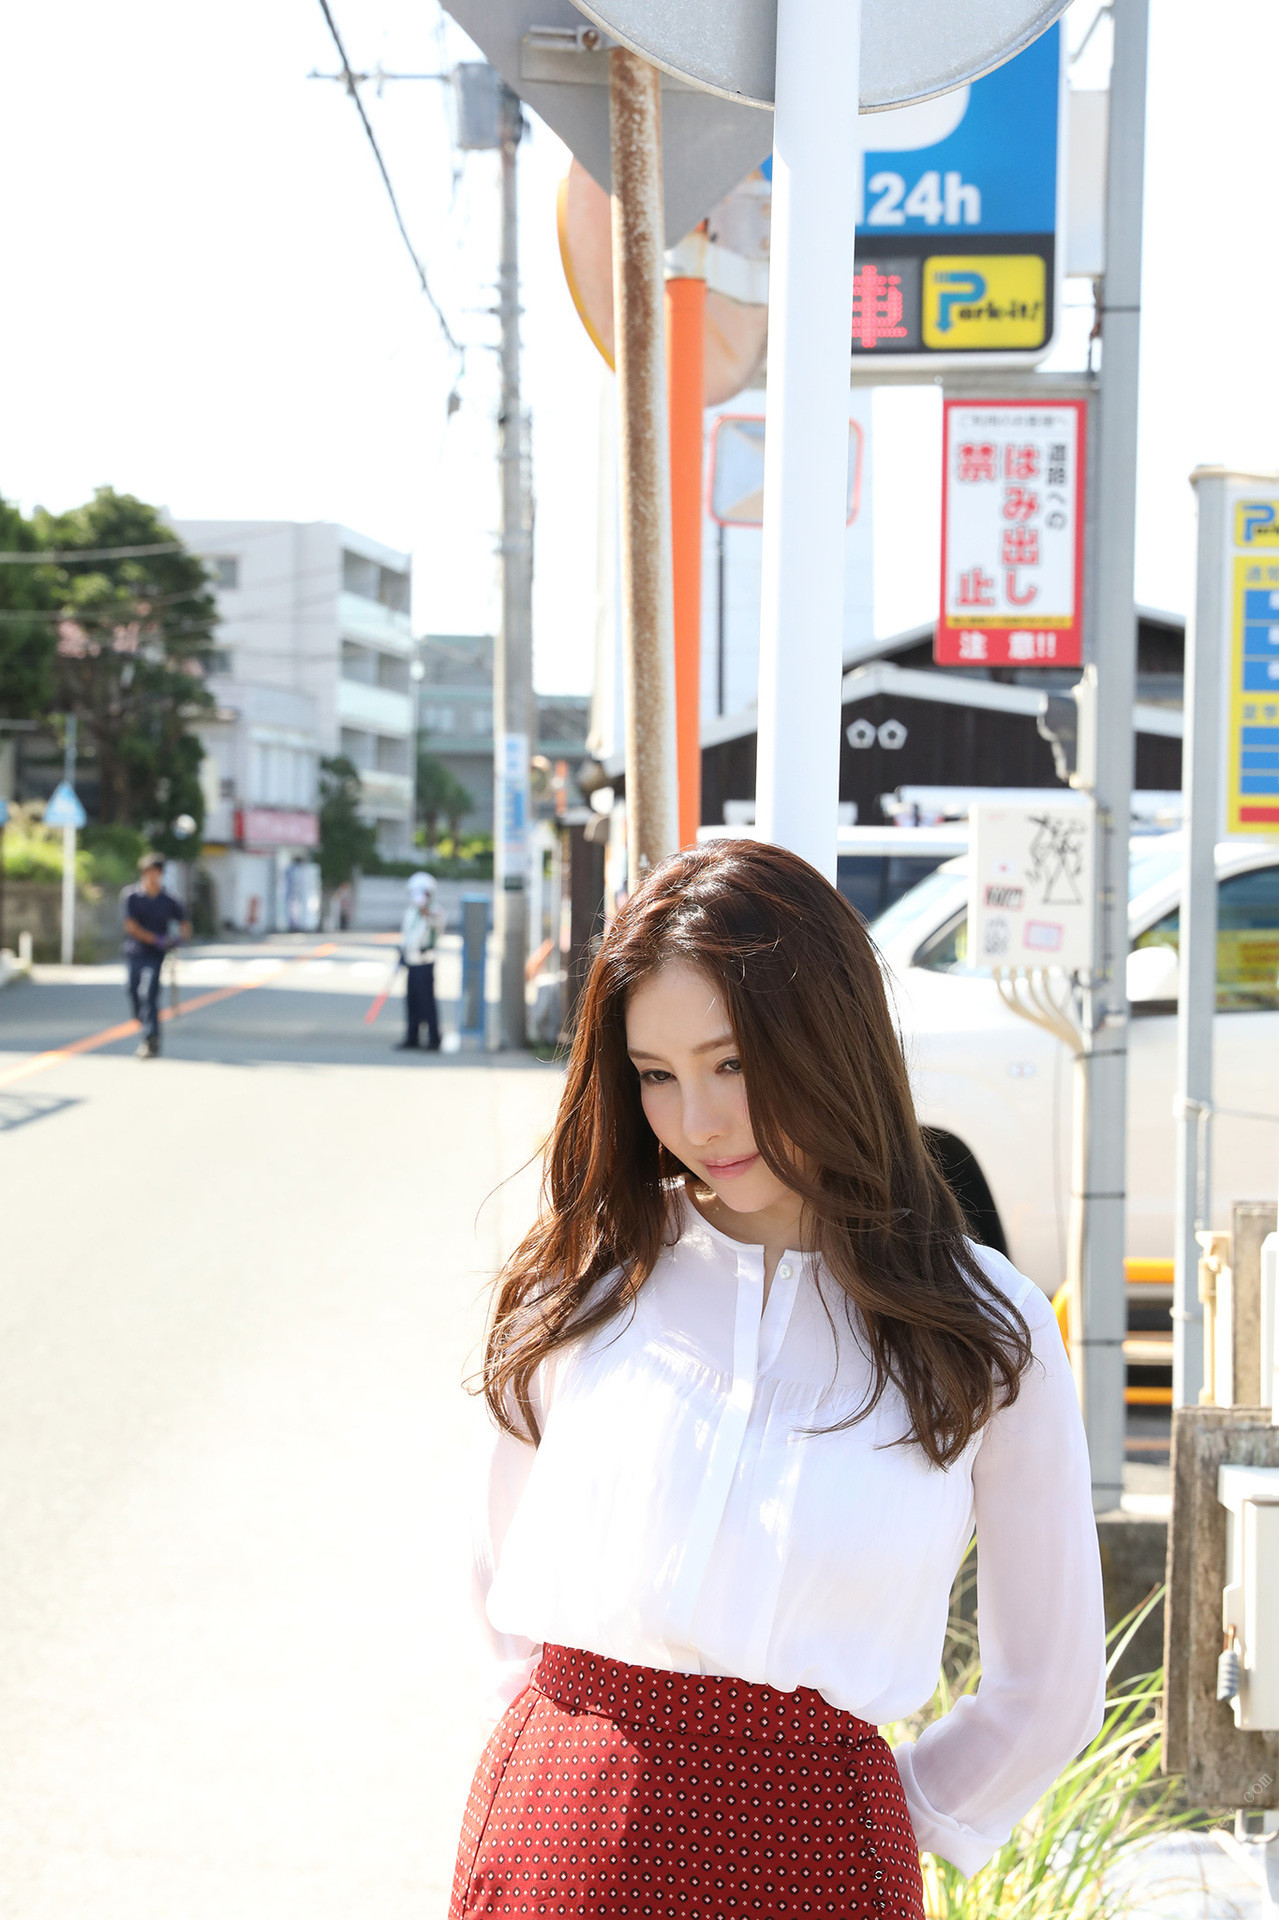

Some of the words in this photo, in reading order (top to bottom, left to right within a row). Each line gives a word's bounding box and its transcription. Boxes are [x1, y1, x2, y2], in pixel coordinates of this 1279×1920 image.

[868, 171, 982, 226] 24h
[1002, 443, 1041, 607] はみ出し
